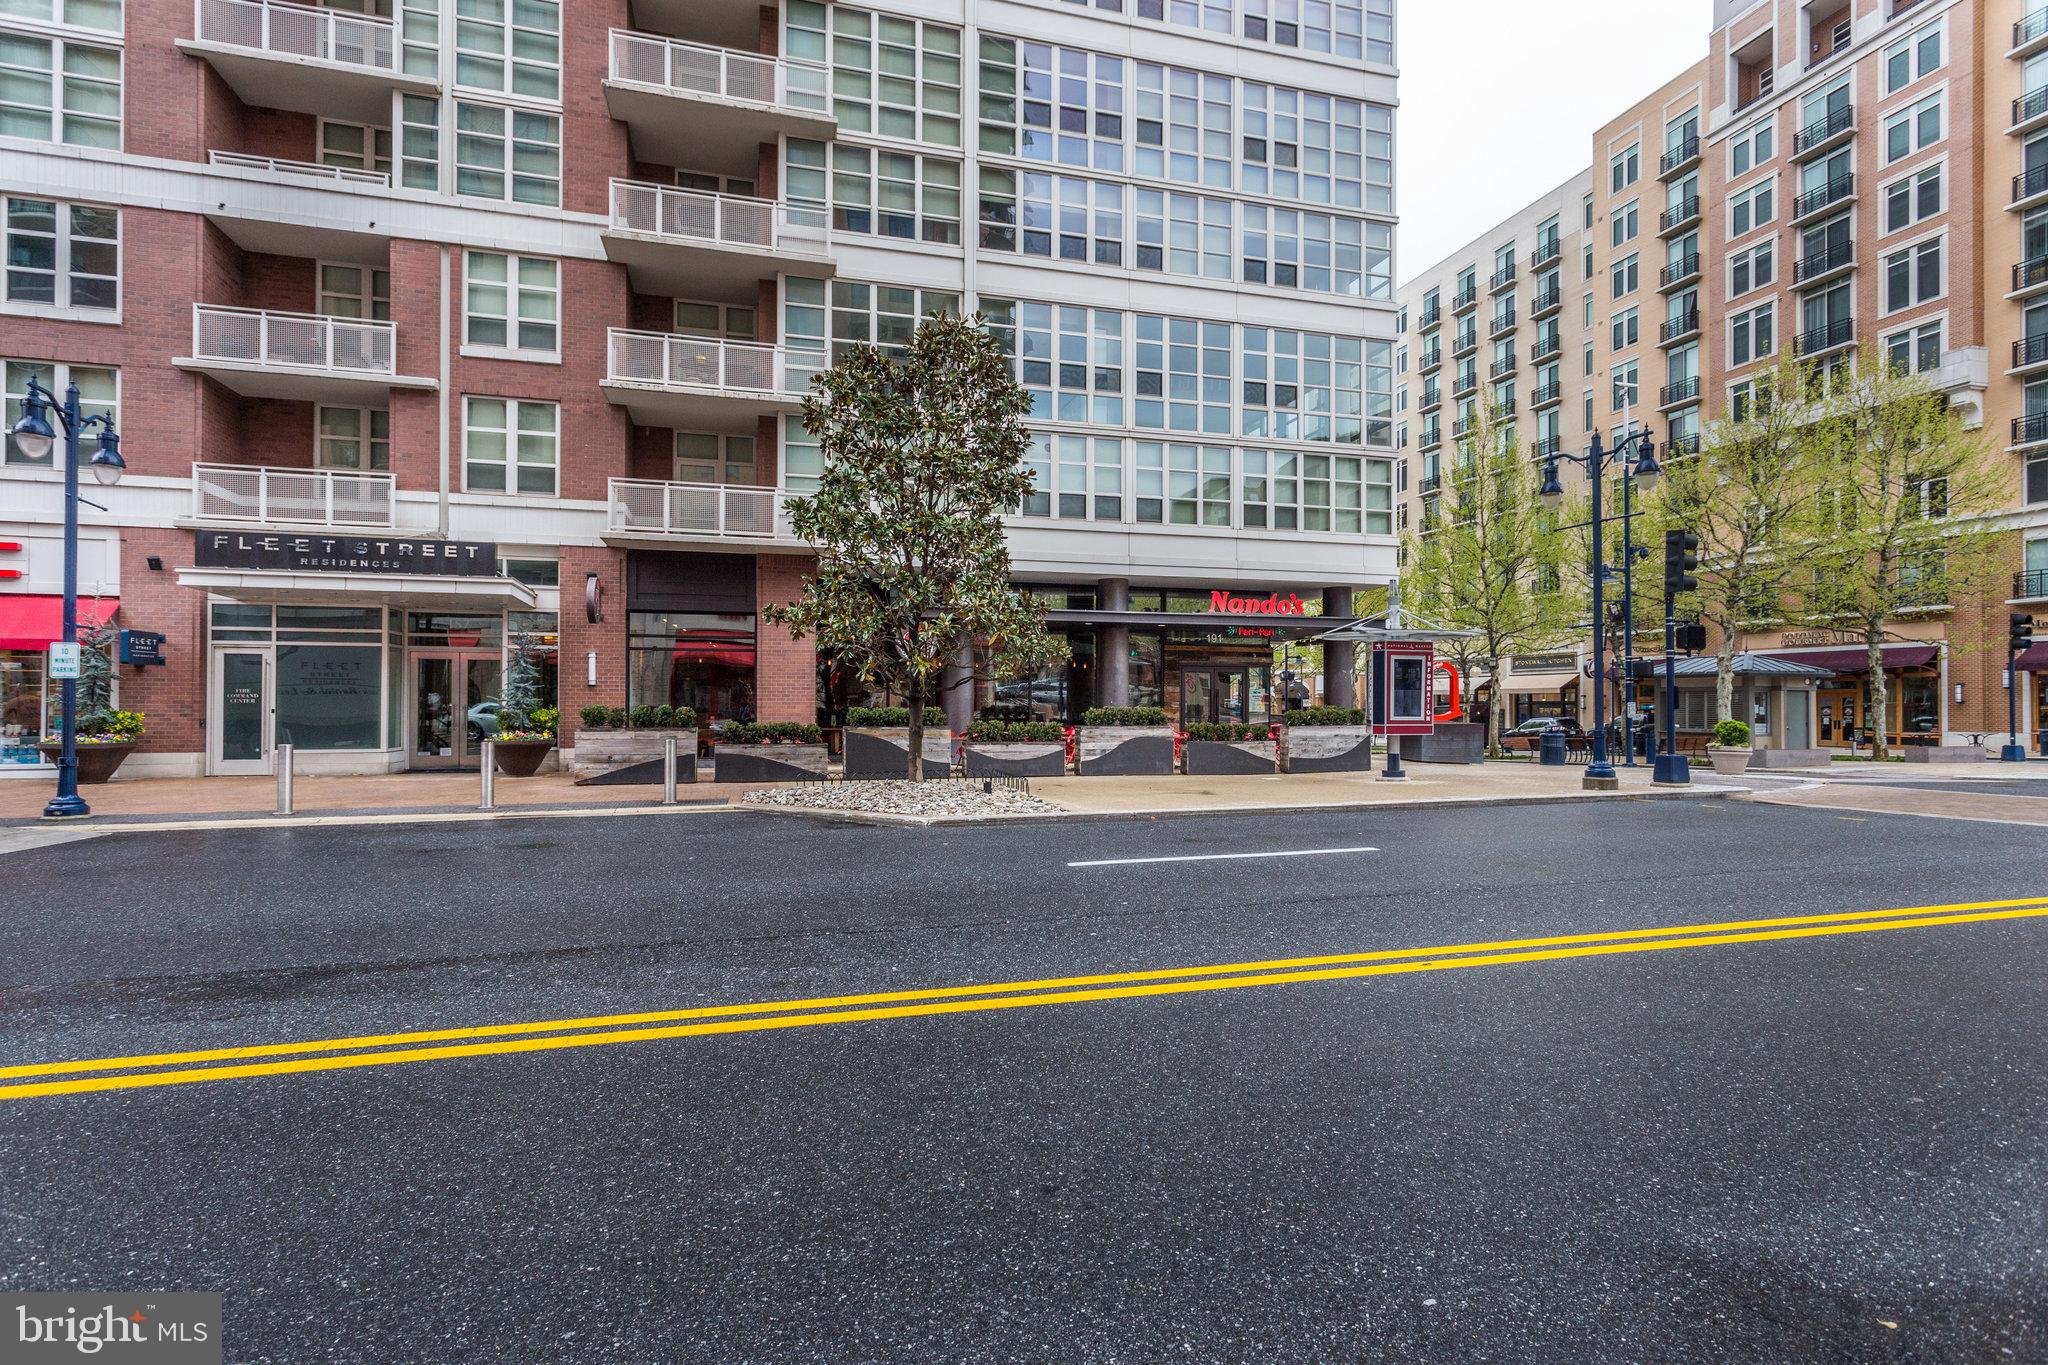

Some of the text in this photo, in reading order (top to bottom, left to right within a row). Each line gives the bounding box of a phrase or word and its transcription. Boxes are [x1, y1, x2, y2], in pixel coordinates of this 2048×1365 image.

[213, 535, 479, 558] FLEET STREET
[300, 557, 400, 568] RESIDENCES
[1208, 590, 1304, 615] Nando's
[1238, 627, 1275, 636] Peri-Peri
[130, 637, 157, 646] FLEET
[1206, 634, 1222, 642] 191
